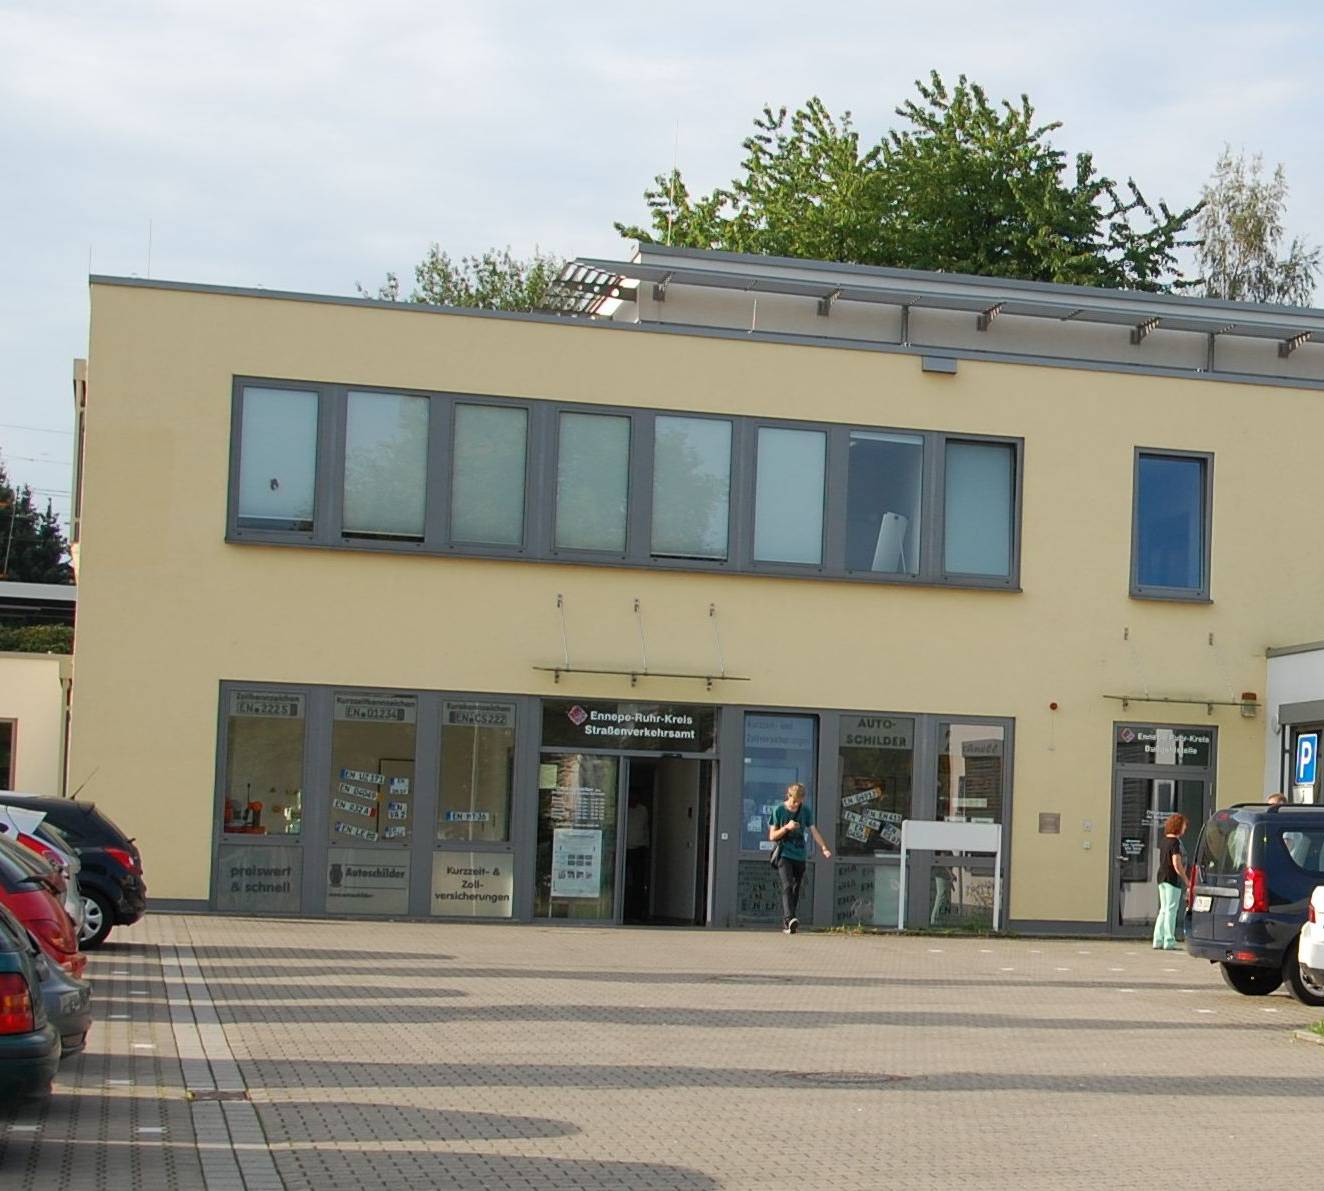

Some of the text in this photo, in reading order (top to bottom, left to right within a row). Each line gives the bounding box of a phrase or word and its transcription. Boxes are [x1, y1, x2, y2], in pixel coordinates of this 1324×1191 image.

[590, 710, 693, 725] Ennepe-Ruhr-Kreis
[858, 718, 897, 729] AUTO-
[585, 725, 695, 739] Straßenverkehrsamt
[846, 734, 906, 747] SCHILDER
[1300, 741, 1312, 778] P
[230, 865, 292, 878] preiswert
[345, 867, 405, 879] Autoschilder
[447, 866, 500, 876] Kurzzeit- &
[245, 881, 291, 893] schnell
[461, 880, 484, 888] Zoll-
[435, 890, 510, 903] versicherungen
